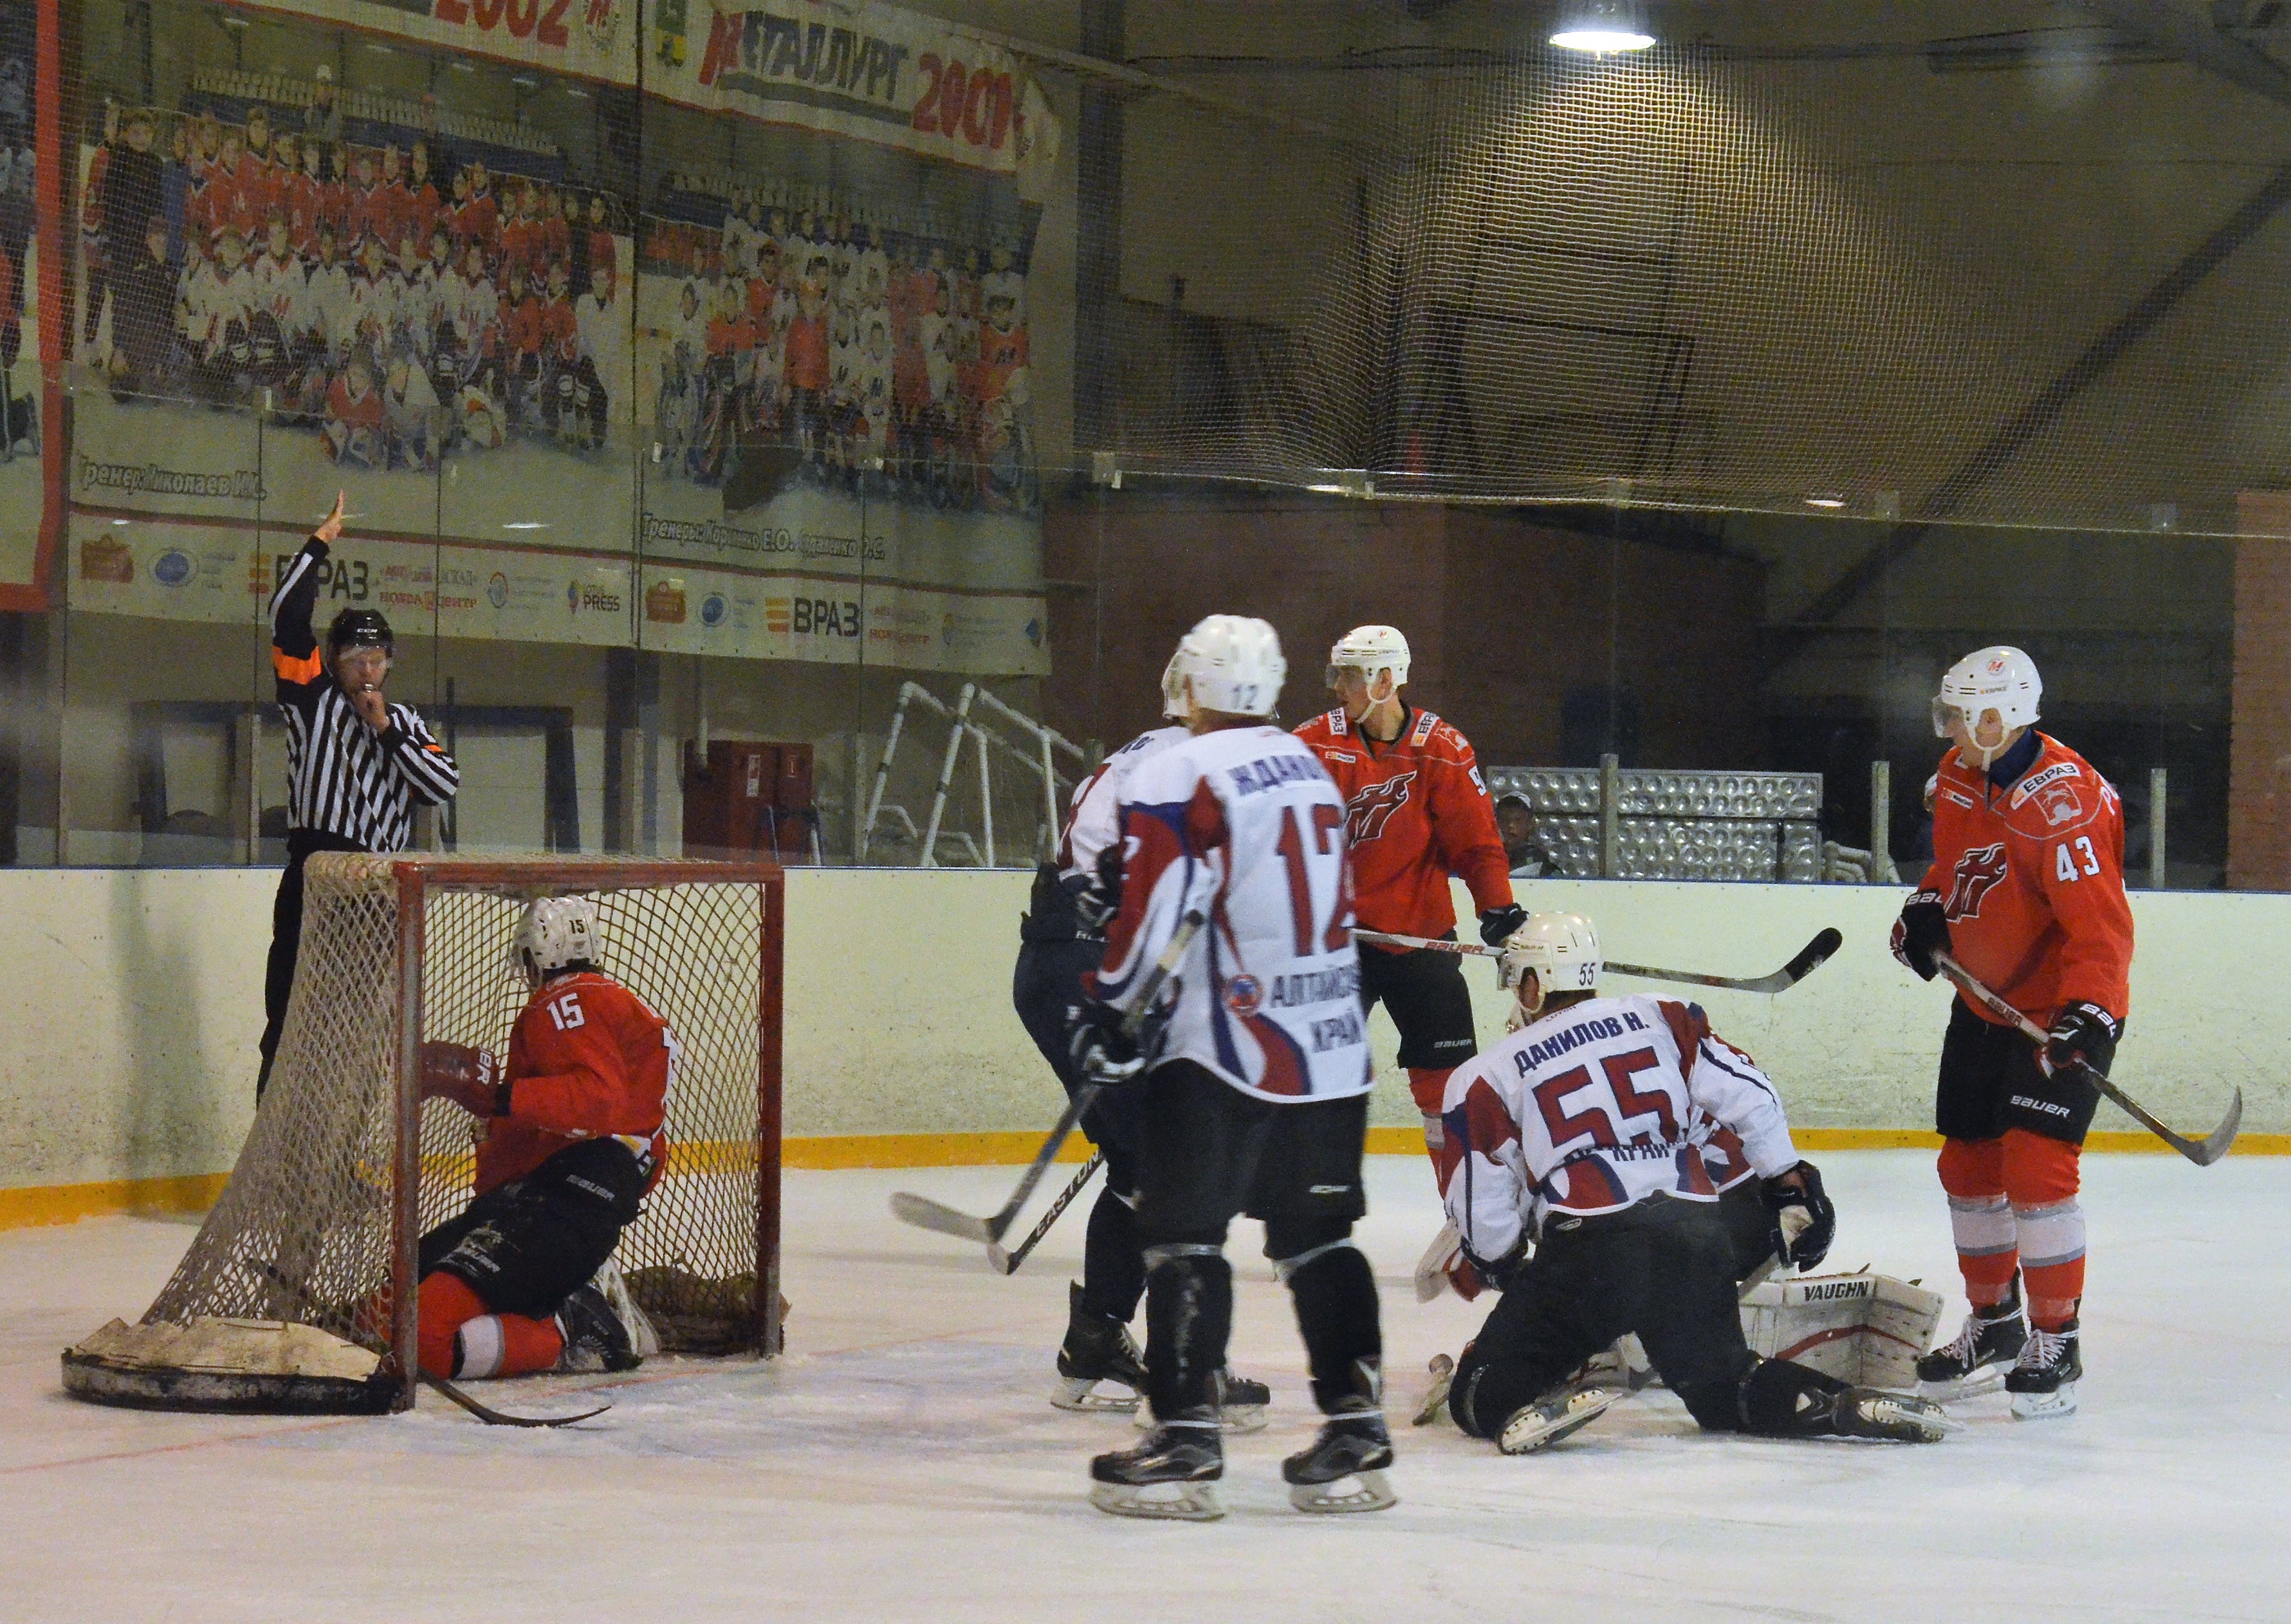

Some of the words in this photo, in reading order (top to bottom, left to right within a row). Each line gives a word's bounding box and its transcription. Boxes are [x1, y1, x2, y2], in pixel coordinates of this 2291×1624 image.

[584, 594, 621, 612] PRESS
[1231, 683, 1259, 710] 12
[1227, 755, 1329, 796] ЖДАНО
[2023, 764, 2077, 793] ЕВРАЗ
[2056, 836, 2101, 882] 43
[569, 919, 585, 934] 15
[1424, 941, 1486, 954] BAUER
[1579, 962, 1596, 986] 55
[546, 992, 585, 1031] 15
[1433, 1038, 1473, 1049] BAUER
[1513, 1017, 1623, 1077] ДАНИЛОВ
[1622, 1011, 1650, 1031] Н.
[1531, 1045, 1679, 1150] 55
[2010, 1094, 2070, 1119] BAUER
[566, 1174, 615, 1202] BAUER
[1035, 1150, 1100, 1237] EASTON
[1803, 1280, 1869, 1302] VAUGHN
